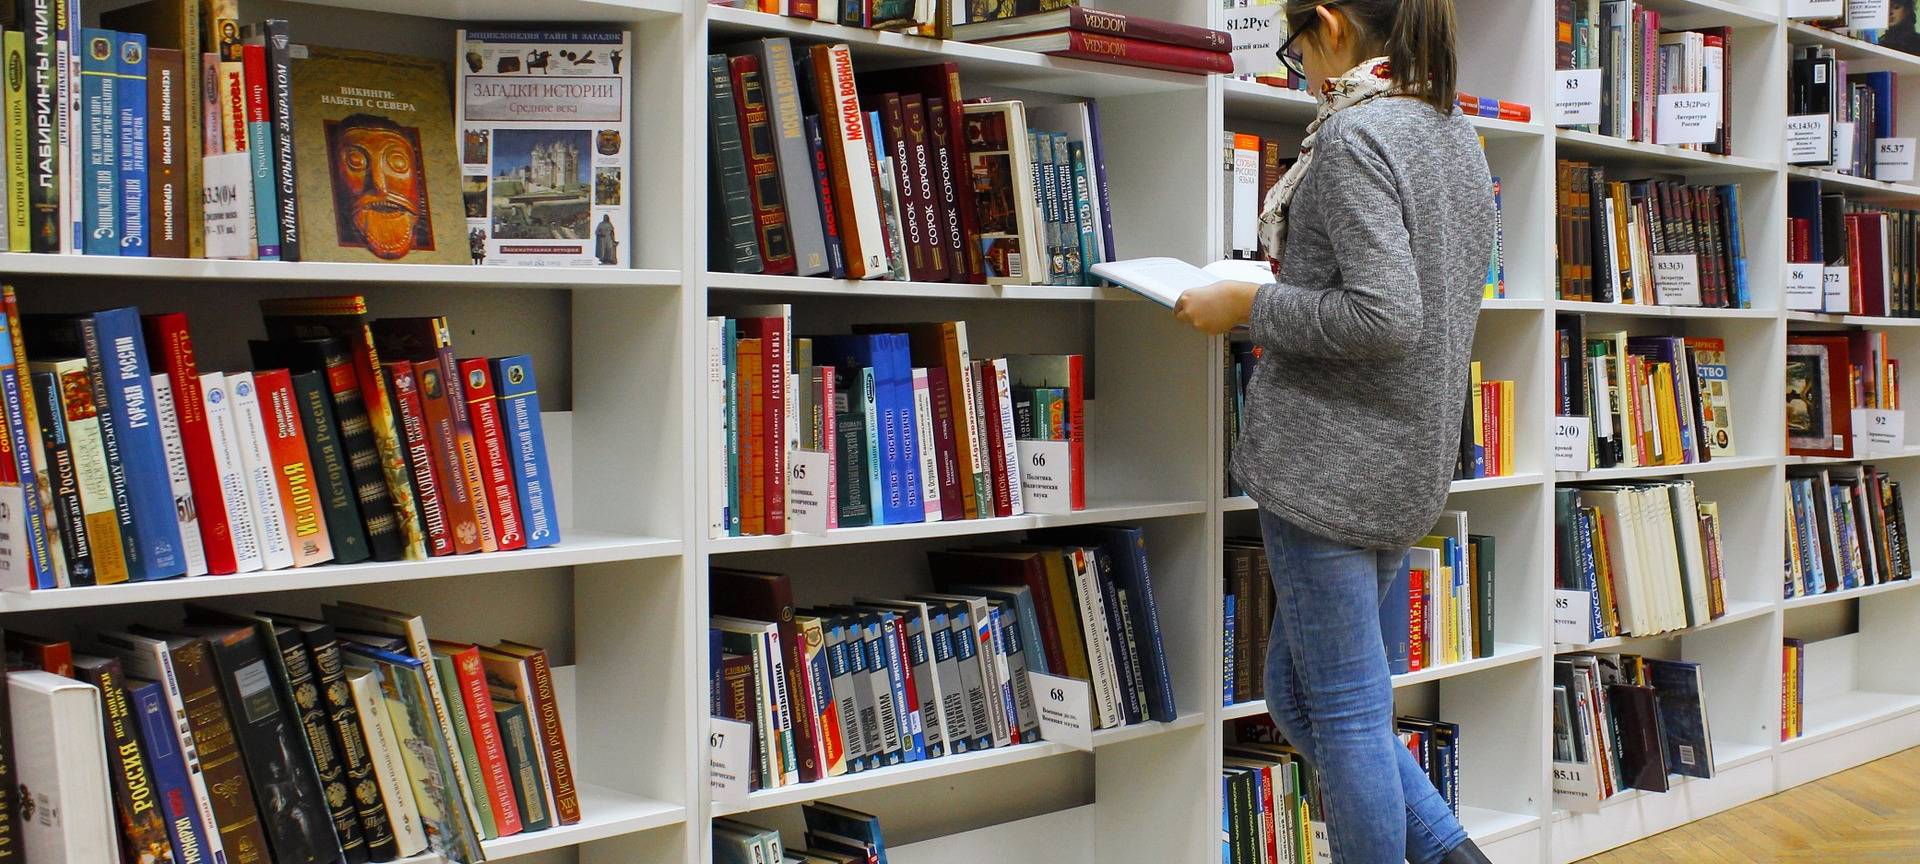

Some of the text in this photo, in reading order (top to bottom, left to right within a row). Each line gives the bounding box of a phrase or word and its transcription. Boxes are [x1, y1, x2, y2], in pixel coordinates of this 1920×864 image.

[468, 32, 540, 41] ЭНЦИКЛОПЕДИЯ
[543, 32, 568, 40] ТАЙН
[581, 32, 621, 41] ЗАГАДОК
[1084, 15, 1126, 33] МОСКВА
[1227, 17, 1269, 31] 81.2Рус
[1083, 36, 1126, 58] МОСКВА
[340, 86, 395, 99] ВИКИНГИ:
[473, 83, 613, 99] ЗАГАДКИ ИСТОРИИ
[768, 43, 801, 139] МОСКВА ВОЕННАЯ
[833, 48, 855, 96] ВОЕННАЯ
[1565, 78, 1578, 89] 83
[121, 108, 132, 124] МИРА
[276, 63, 290, 131] ЗАБРАЛОМ
[321, 95, 416, 111] НАБЕГИ С СЕВЕРА
[509, 102, 577, 115] Средние века
[894, 109, 898, 119] 1
[913, 114, 918, 123] 2
[1674, 100, 1710, 109] 83.3(2Рос)
[35, 52, 53, 188] ЛАБИРИНТЫ
[90, 95, 101, 164] ВСЕ МОНАРХИ МИРА
[133, 116, 143, 139] ВОСТОК
[252, 84, 268, 178] Средневековый мир
[841, 97, 863, 141] МОСКВА
[12, 99, 26, 226] ИСТОРИЯ ДРЕВНЕГО МИРА
[121, 159, 132, 171] ВСЕ
[161, 70, 172, 240] ВСЕМИРНАЯ ИСТОРИЯ СПРАВОЧНИК
[280, 134, 293, 193] СКРЫТЫЕ
[1880, 144, 1904, 153] 85.37
[896, 139, 920, 243] СОРОК СОРОКОВ
[914, 143, 939, 245] СОРОК СОРОКОВ
[938, 146, 961, 249] СОРОК СОРОКОВ
[1042, 164, 1053, 199] ИСТОРИЯ
[1057, 165, 1069, 201] ИСТОРИЯ
[1063, 164, 1077, 221] ЦИВИЛИЗАЦИИ
[1076, 175, 1093, 233] ВЕСЬ МИР
[1657, 262, 1683, 270] 83.3(3)
[1792, 271, 1803, 279] 86
[1823, 273, 1839, 282] 372
[113, 335, 149, 428] ГОРОДА РОССИИ
[169, 331, 193, 423] Иллюстрированная
[178, 327, 202, 421] история СССР
[996, 368, 1008, 399] А-Я
[4, 373, 22, 425] ИСТОРИЯ
[15, 428, 31, 474] РОССИИ
[269, 390, 288, 438] Справочник
[278, 386, 297, 436] абитуриента
[478, 401, 496, 437] КУЛЬТУРЫ
[512, 397, 530, 430] ИСТОРИИ
[962, 366, 981, 468] Экономическая азбука
[1000, 404, 1013, 439] БИЗНЕС
[306, 389, 349, 508] История России
[485, 437, 502, 467] РУССКОЙ
[518, 430, 535, 461] РУССКОЙ
[885, 409, 895, 460] МОСКВИЧИ
[99, 412, 133, 524] ЦАРСКИЕ ДИНАСТИИ
[440, 417, 467, 503] ПОЛКОВОДЦЫ РОССИИ
[492, 466, 505, 483] МИР
[523, 461, 538, 477] МИР
[793, 464, 805, 479] 65
[871, 439, 880, 480] ЭКОНОМИКА
[901, 409, 916, 505] МЫ ВСЕ МОСКВИЧИ
[1032, 452, 1045, 466] 66
[407, 443, 446, 536] ЭНЦИКЛОПЕДИЯ
[461, 441, 491, 541] РОССИЙСКАЯ ИМПЕРИЯ
[891, 489, 899, 506] МЫ
[998, 472, 1007, 507] РЫНОК:
[1005, 451, 1021, 507] ЭКОНОМИКА
[1033, 491, 1048, 499] наука
[28, 513, 50, 573] ШКОЛЬНИКА
[1890, 520, 1904, 575] СЛОВАРЬ
[1583, 522, 1603, 633] ИСКУССТВО XX ВЕКА
[1120, 599, 1134, 642] СЛУЖБА
[1555, 598, 1567, 608] 85
[533, 655, 551, 699] КУЛЬТУРЫ
[888, 634, 900, 680] ПРЕСТУПЛЕНИЯ
[98, 672, 125, 738] ВСЕ МОНАРХИ
[113, 687, 129, 717] МИРА
[469, 679, 488, 720] ИСТОРИИ
[774, 662, 790, 728] ПРИЗЫВНИКА
[812, 661, 825, 709] СПРАВОЧНИК
[1050, 687, 1064, 702] 68
[540, 701, 561, 746] РУССКОЙ
[877, 692, 899, 748] ЖЕНЩИНАМ
[896, 690, 908, 733] ПРЕСТУПНИКИ
[923, 699, 938, 727] ДЕТЯХ
[943, 694, 959, 737] ОБРАТИТЕСЬ
[952, 691, 966, 727] АДВОКАТУ
[968, 686, 989, 734] ПРАВОСУДИЕ
[479, 721, 499, 760] РУССКОЙ
[710, 732, 724, 749] 67
[115, 738, 155, 814] РОССИЯ
[551, 748, 570, 793] ИСТОРИЯ
[1553, 769, 1580, 780] 85.11
[490, 762, 515, 825] ТЫСЯЧЕЛЕТИЕ
[560, 798, 576, 809] XIX
[376, 825, 382, 837] 2
